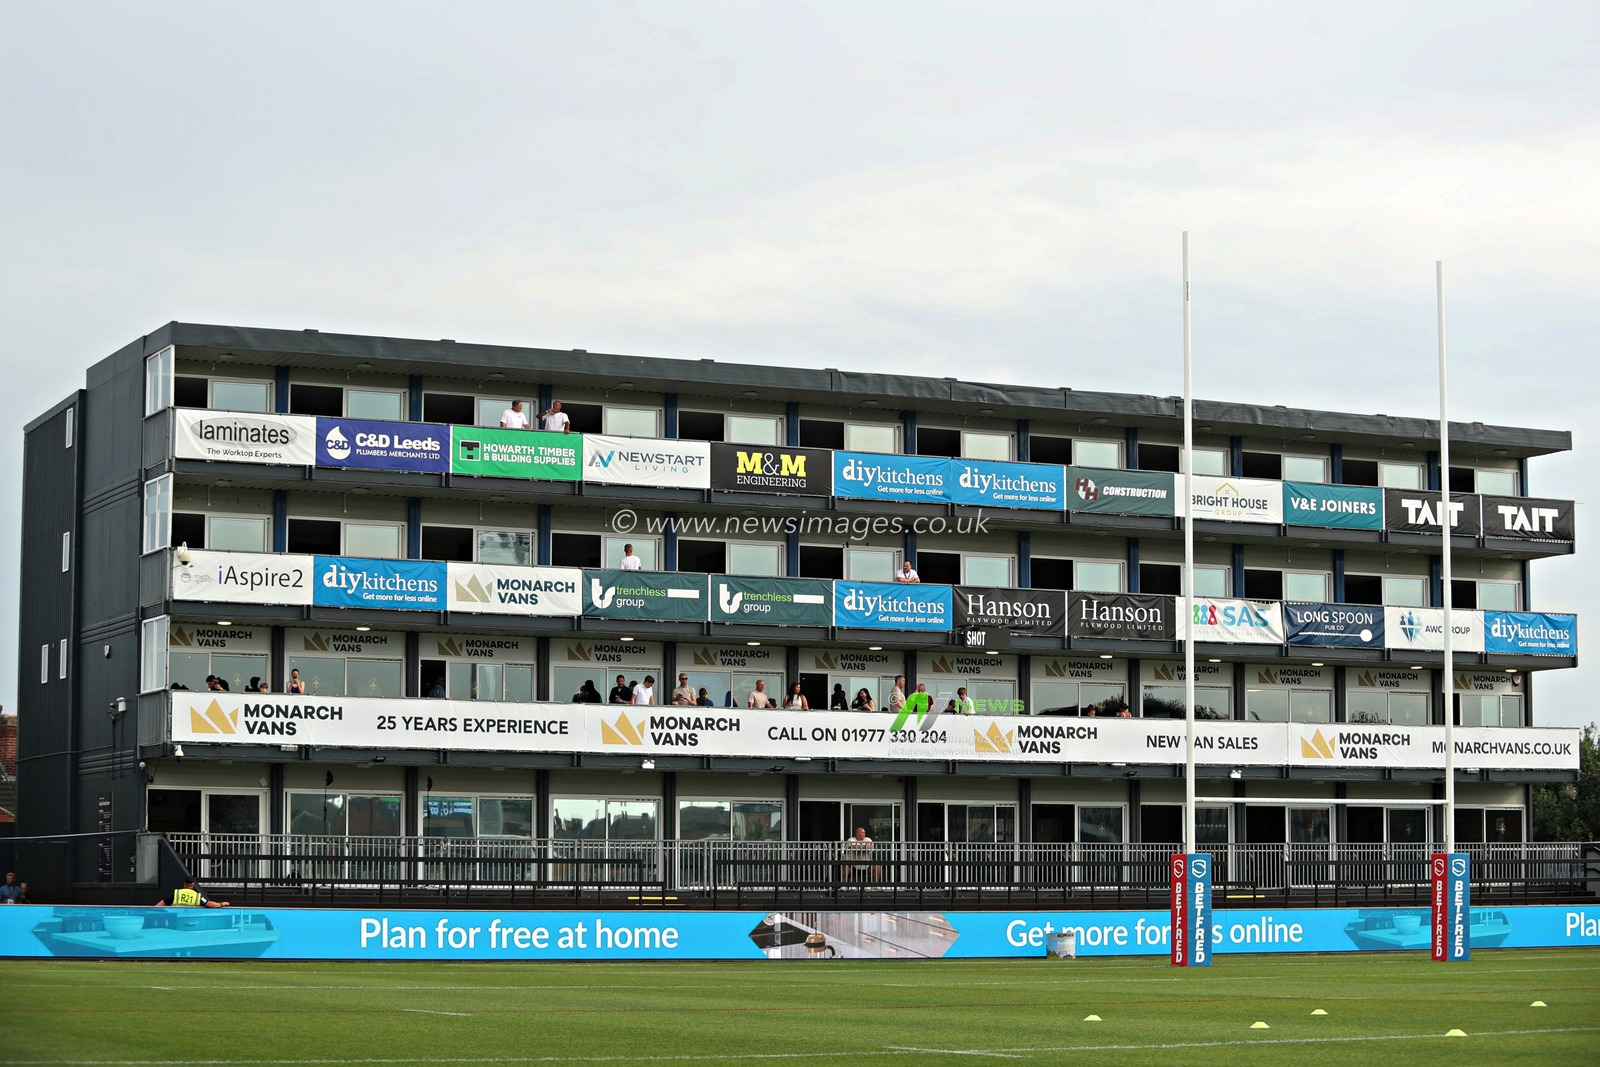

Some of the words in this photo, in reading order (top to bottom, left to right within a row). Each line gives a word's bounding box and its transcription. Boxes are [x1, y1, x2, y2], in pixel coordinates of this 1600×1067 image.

[199, 419, 290, 445] laminates
[327, 440, 350, 450] C&D
[355, 432, 390, 448] C&D
[394, 435, 441, 451] Leeds
[207, 448, 221, 456] The
[222, 449, 253, 458] Worktop
[254, 451, 282, 459] Experts
[356, 449, 388, 457] PLUMBERS
[389, 451, 428, 459] MERCHANTS
[483, 443, 535, 455] HOWARTH
[538, 446, 576, 458] TIMBER
[483, 452, 490, 461] &
[491, 452, 532, 464] BUILDING
[534, 455, 576, 466] SUPPLIES
[618, 451, 705, 467] NEWSTART
[736, 451, 807, 478] M&M
[634, 464, 689, 474] LIVING
[842, 459, 944, 488] diykitchens
[736, 475, 807, 488] ENGINEERING
[959, 467, 1056, 494] diykitchens
[877, 485, 888, 493] Get
[904, 486, 914, 494] for
[914, 487, 925, 495] less
[926, 488, 944, 496] online
[1102, 486, 1167, 499] CONSTRUCTION
[992, 492, 1003, 500] Get
[1004, 494, 1019, 502] more
[1028, 494, 1039, 502] less
[1040, 495, 1056, 503] online
[1232, 497, 1268, 510] HOUSE
[1290, 496, 1316, 511] V&E
[1320, 499, 1376, 515] JOINERS
[1214, 509, 1242, 517] GROUP
[1401, 498, 1464, 527] TAIT
[1498, 505, 1559, 532] TAIT
[218, 565, 303, 591] iAspire2
[322, 564, 438, 594] diykitchens
[497, 578, 575, 594] MONARCH
[616, 585, 666, 598] trenchless
[362, 592, 375, 600] Get
[376, 594, 393, 602] more
[394, 593, 404, 601] for
[404, 594, 417, 602] less
[418, 595, 438, 603] online
[498, 592, 539, 606] VANS
[744, 591, 792, 602] trenchless
[843, 588, 944, 617] diykitchens
[616, 598, 644, 609] group
[744, 603, 771, 614] group
[966, 594, 1052, 618] Hanson
[1080, 600, 1162, 624] Hanson
[1222, 606, 1269, 628] SAS
[1297, 611, 1330, 623] LONG
[1332, 612, 1373, 625] SPOON
[878, 614, 889, 622] Get
[915, 616, 926, 624] less
[926, 616, 944, 624] online
[197, 629, 252, 640] MONARCH
[1424, 625, 1443, 634] AWC
[1451, 626, 1470, 635] ROUP
[1490, 618, 1570, 642] diykitchens
[197, 638, 226, 648] VANS
[332, 634, 387, 644] MONARCH
[466, 640, 518, 650] MONARCH
[966, 631, 986, 646] SHOT
[333, 644, 362, 652] VANS
[466, 648, 494, 658] VANS
[594, 644, 646, 654] MONARCH
[720, 649, 770, 659] MONARCH
[594, 654, 622, 662] VANS
[720, 658, 746, 667] VANS
[840, 653, 888, 663] MONARCH
[956, 658, 1003, 667] MONARCH
[840, 662, 866, 670] VANS
[956, 666, 981, 674] VANS
[1068, 662, 1113, 670] MONARCH
[1176, 665, 1219, 674] MARCH
[1069, 669, 1093, 678] VANS
[1177, 673, 1200, 681] VAS
[1280, 669, 1321, 677] MONARCH
[1379, 672, 1418, 680] MONARCH
[1473, 675, 1511, 683] MONARCH
[1379, 680, 1400, 688] VANS
[244, 704, 343, 720] MONARCH
[244, 720, 297, 736] VANS
[376, 715, 396, 730] 25
[401, 716, 458, 732] YEARS
[463, 718, 568, 734] EXPERIENCE
[650, 716, 741, 732] MONARCH
[650, 732, 699, 746] VANS
[768, 726, 808, 741] CALL
[812, 727, 837, 742] ON
[842, 728, 885, 743] 01977
[890, 729, 916, 744] 330
[921, 730, 947, 744] 204
[1017, 725, 1098, 740] MONARCH
[1339, 732, 1410, 746] MONARCH
[1018, 740, 1061, 754] VANS
[1146, 735, 1180, 748] NEW
[1185, 736, 1214, 749] AN
[1218, 736, 1259, 750] SALES
[1432, 740, 1572, 756] MNARCHVANS.CO.UK
[1340, 746, 1378, 759] VANS
[180, 894, 193, 904] R21
[1175, 882, 1183, 963] BETFRED
[1194, 882, 1206, 963] BETFRED
[1454, 880, 1464, 957] BETFRED
[1566, 912, 1600, 937] Pla
[360, 918, 426, 948] Plan
[435, 918, 480, 949] for
[488, 918, 550, 949] free
[557, 921, 587, 949] at
[595, 918, 679, 949] home
[1134, 918, 1171, 945] for
[1229, 916, 1303, 943] online
